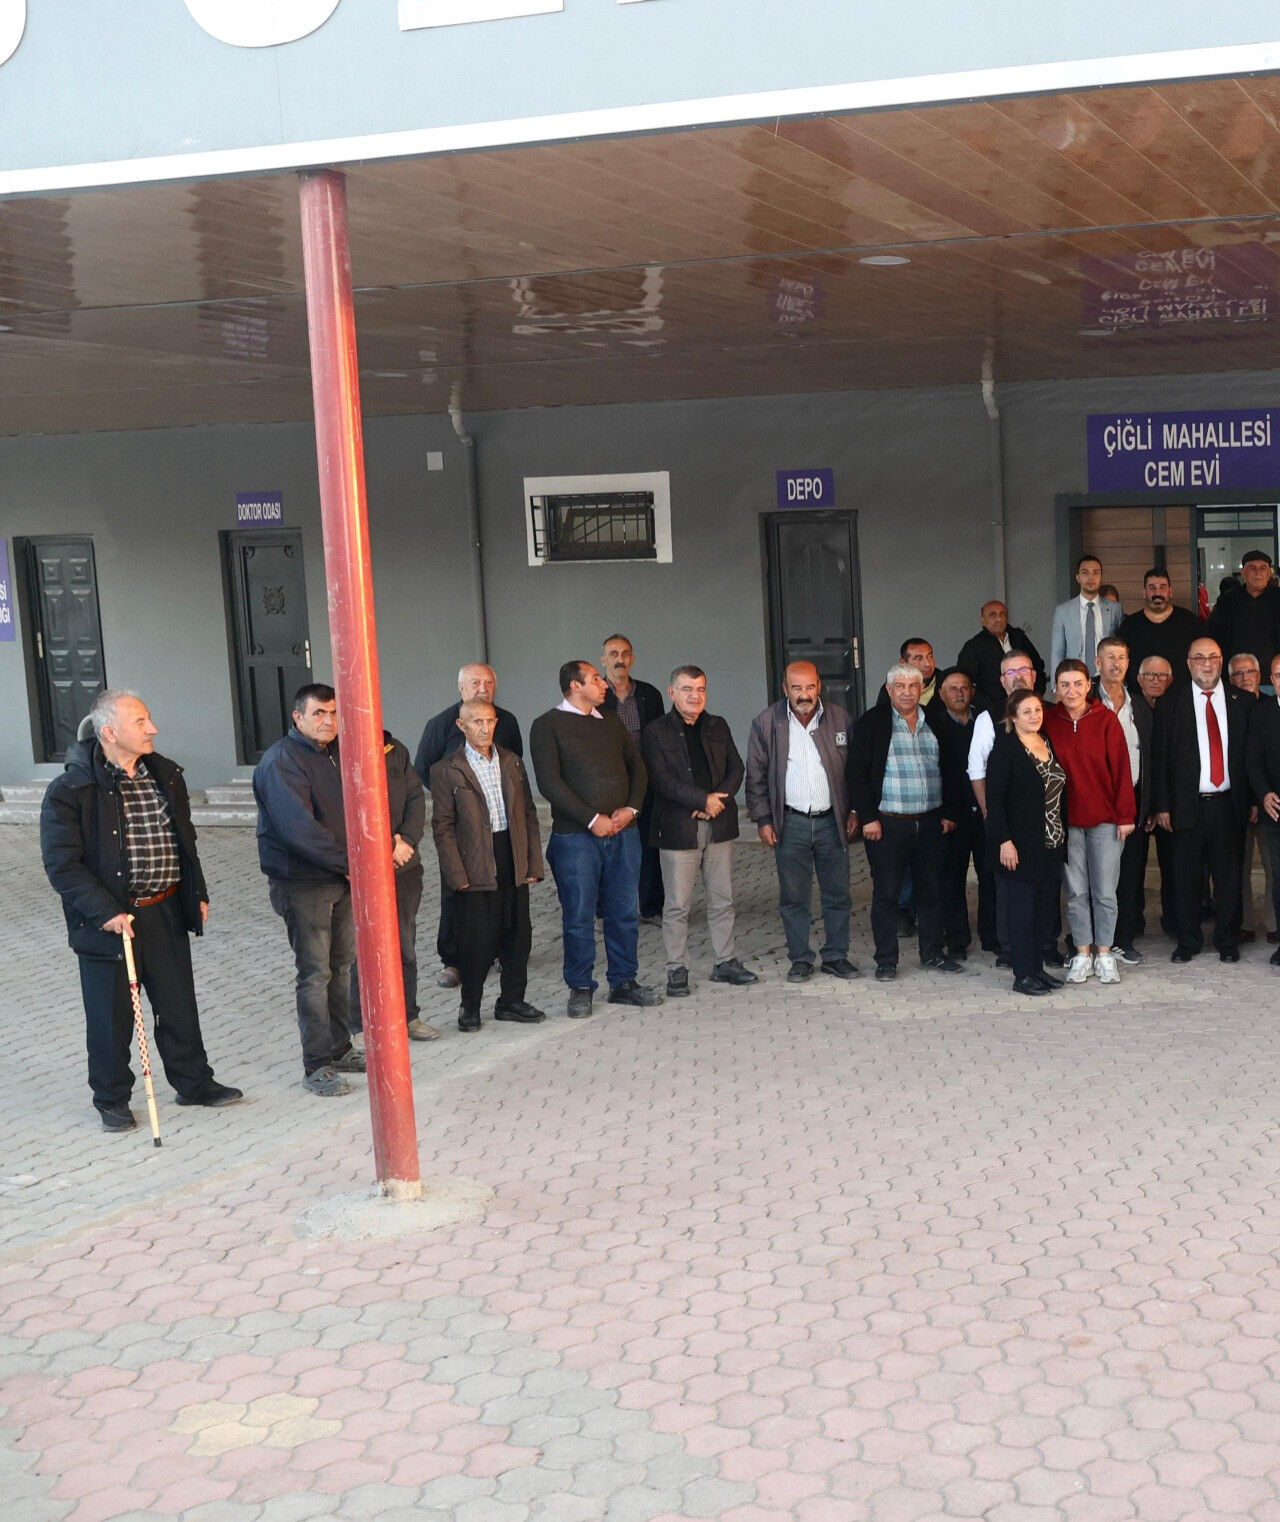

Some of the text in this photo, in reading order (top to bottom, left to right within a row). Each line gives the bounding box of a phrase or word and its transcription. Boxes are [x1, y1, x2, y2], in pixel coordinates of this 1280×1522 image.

[1103, 414, 1271, 458] ÇİĞLİ MAHALLESİ
[1144, 453, 1220, 488] CEM EVİ
[787, 477, 823, 500] DEPO
[237, 502, 281, 520] DOKTOR ODASI
